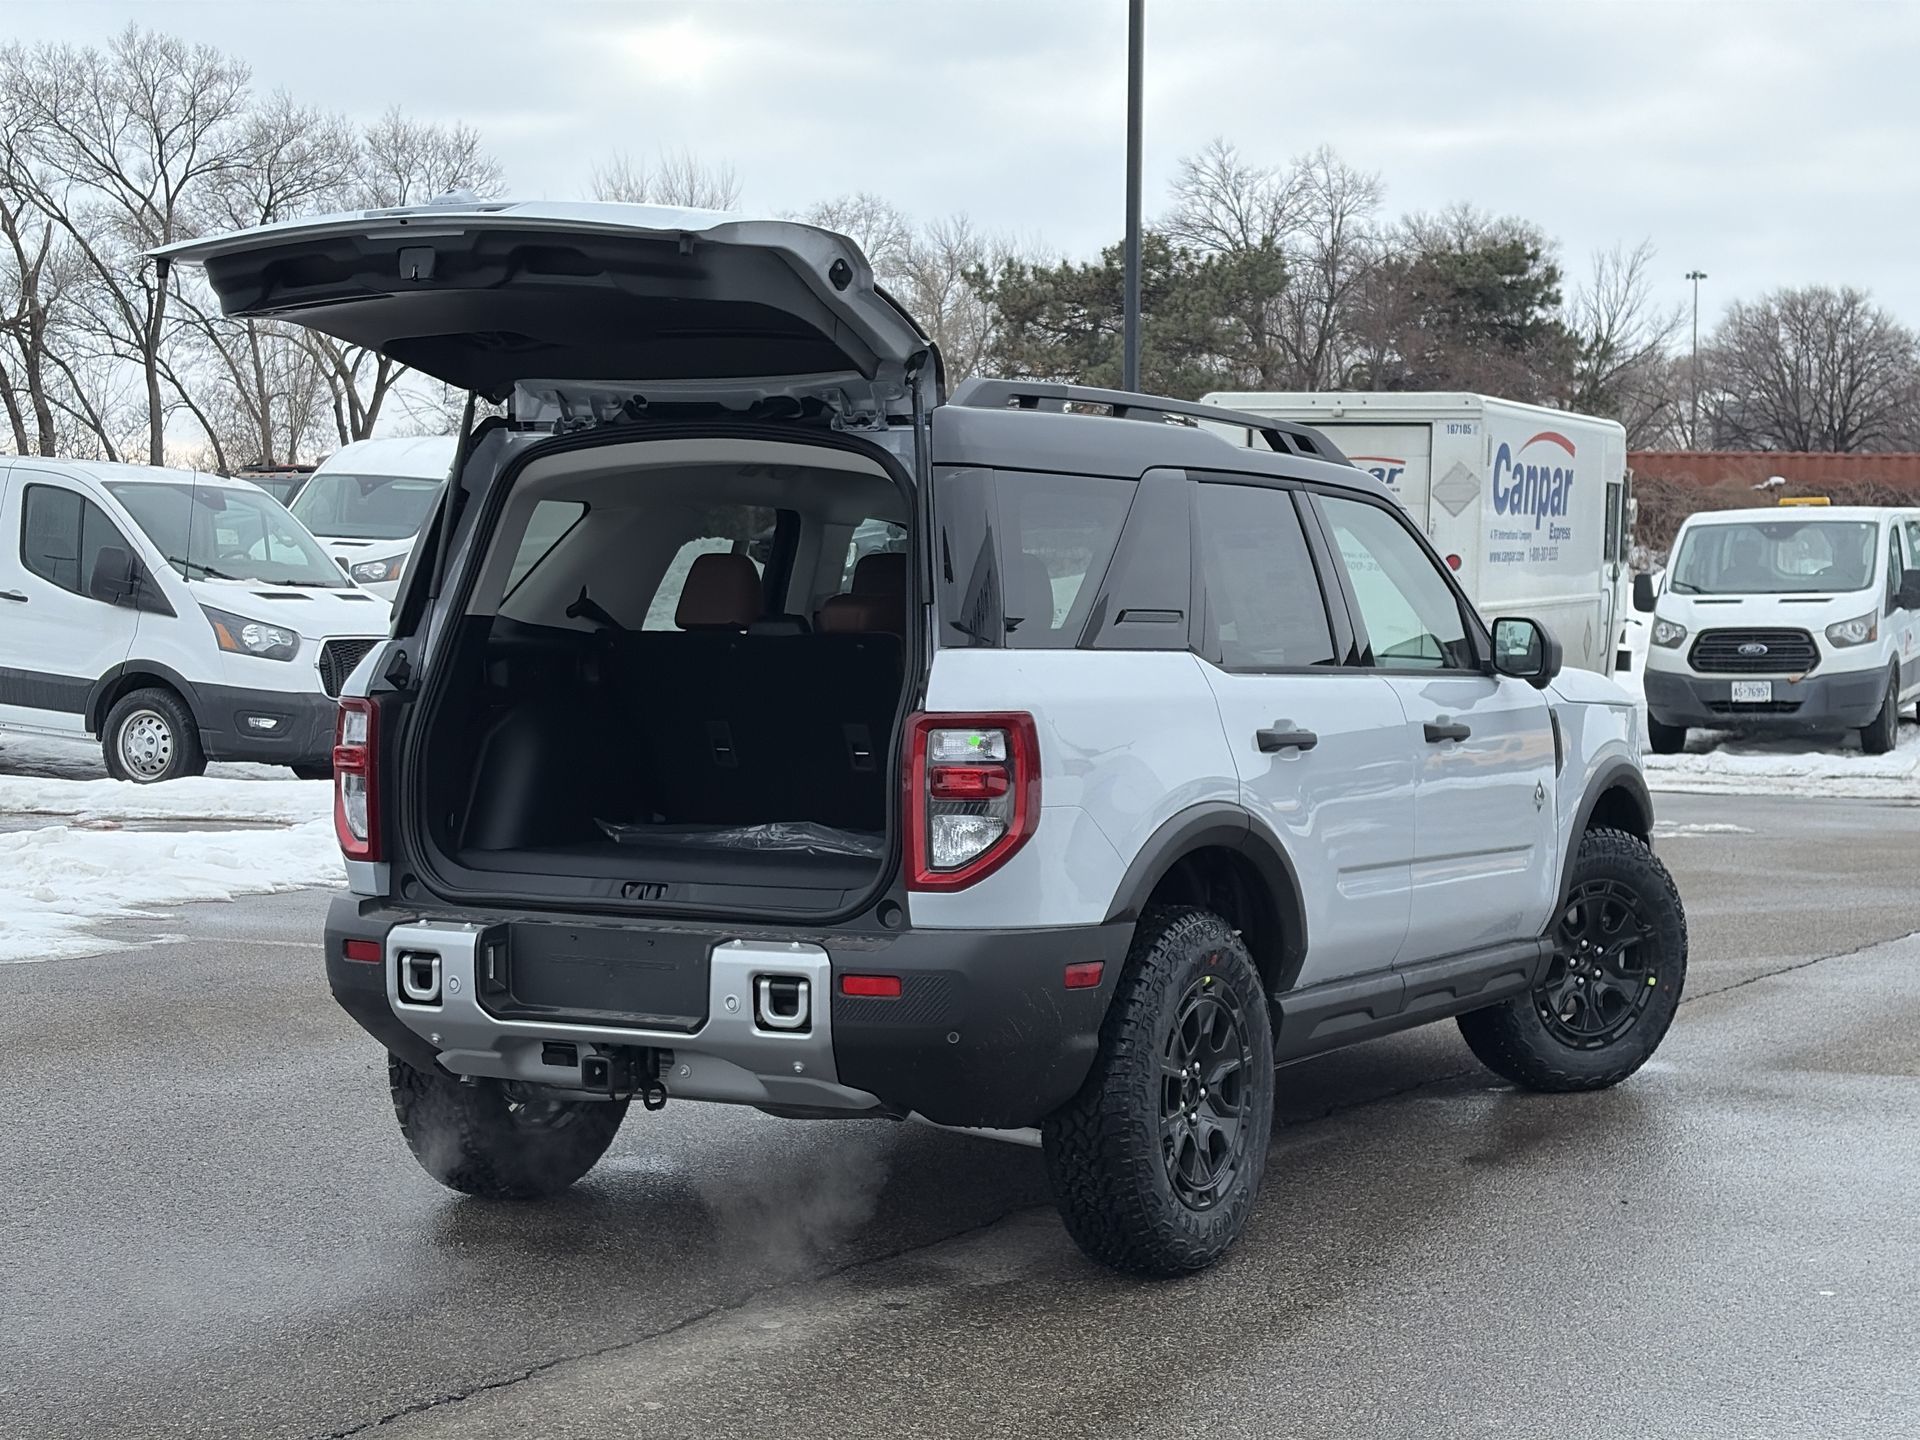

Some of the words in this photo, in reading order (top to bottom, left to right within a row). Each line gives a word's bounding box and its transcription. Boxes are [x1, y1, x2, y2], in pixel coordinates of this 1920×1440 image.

[1493, 442, 1574, 530] Canpar
[1549, 522, 1571, 543] Express
[1489, 551, 1524, 566] www.canpar.com
